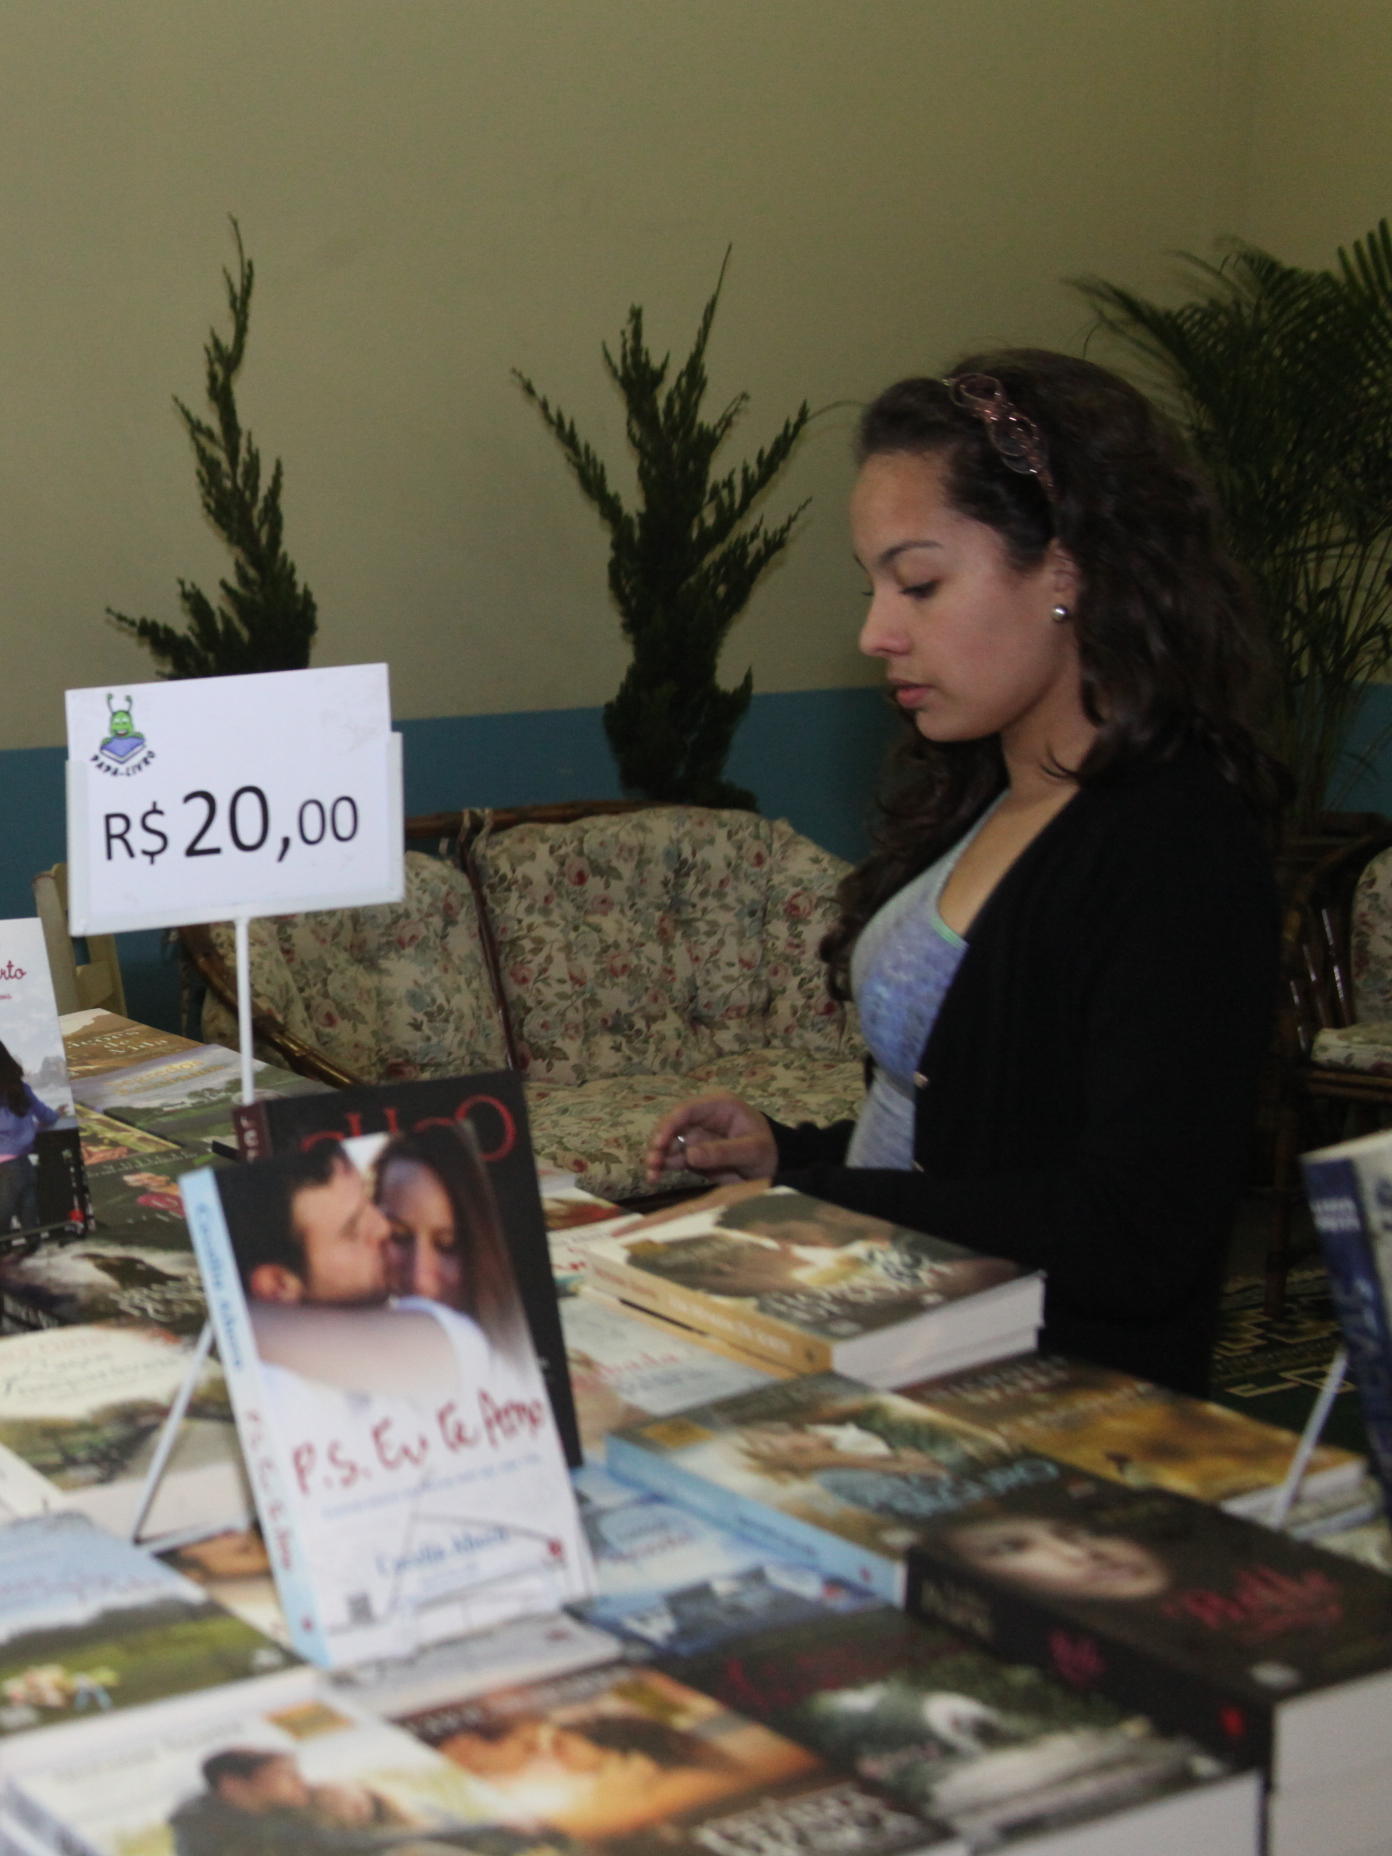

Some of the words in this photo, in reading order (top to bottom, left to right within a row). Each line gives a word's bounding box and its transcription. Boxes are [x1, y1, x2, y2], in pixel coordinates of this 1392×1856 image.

[90, 750, 156, 778] PAPA-LIVRO
[104, 801, 168, 865] R$
[182, 785, 358, 863] 20,00
[292, 1440, 372, 1495] P.S.
[371, 1416, 429, 1472] Eu
[477, 1387, 545, 1450] Amo
